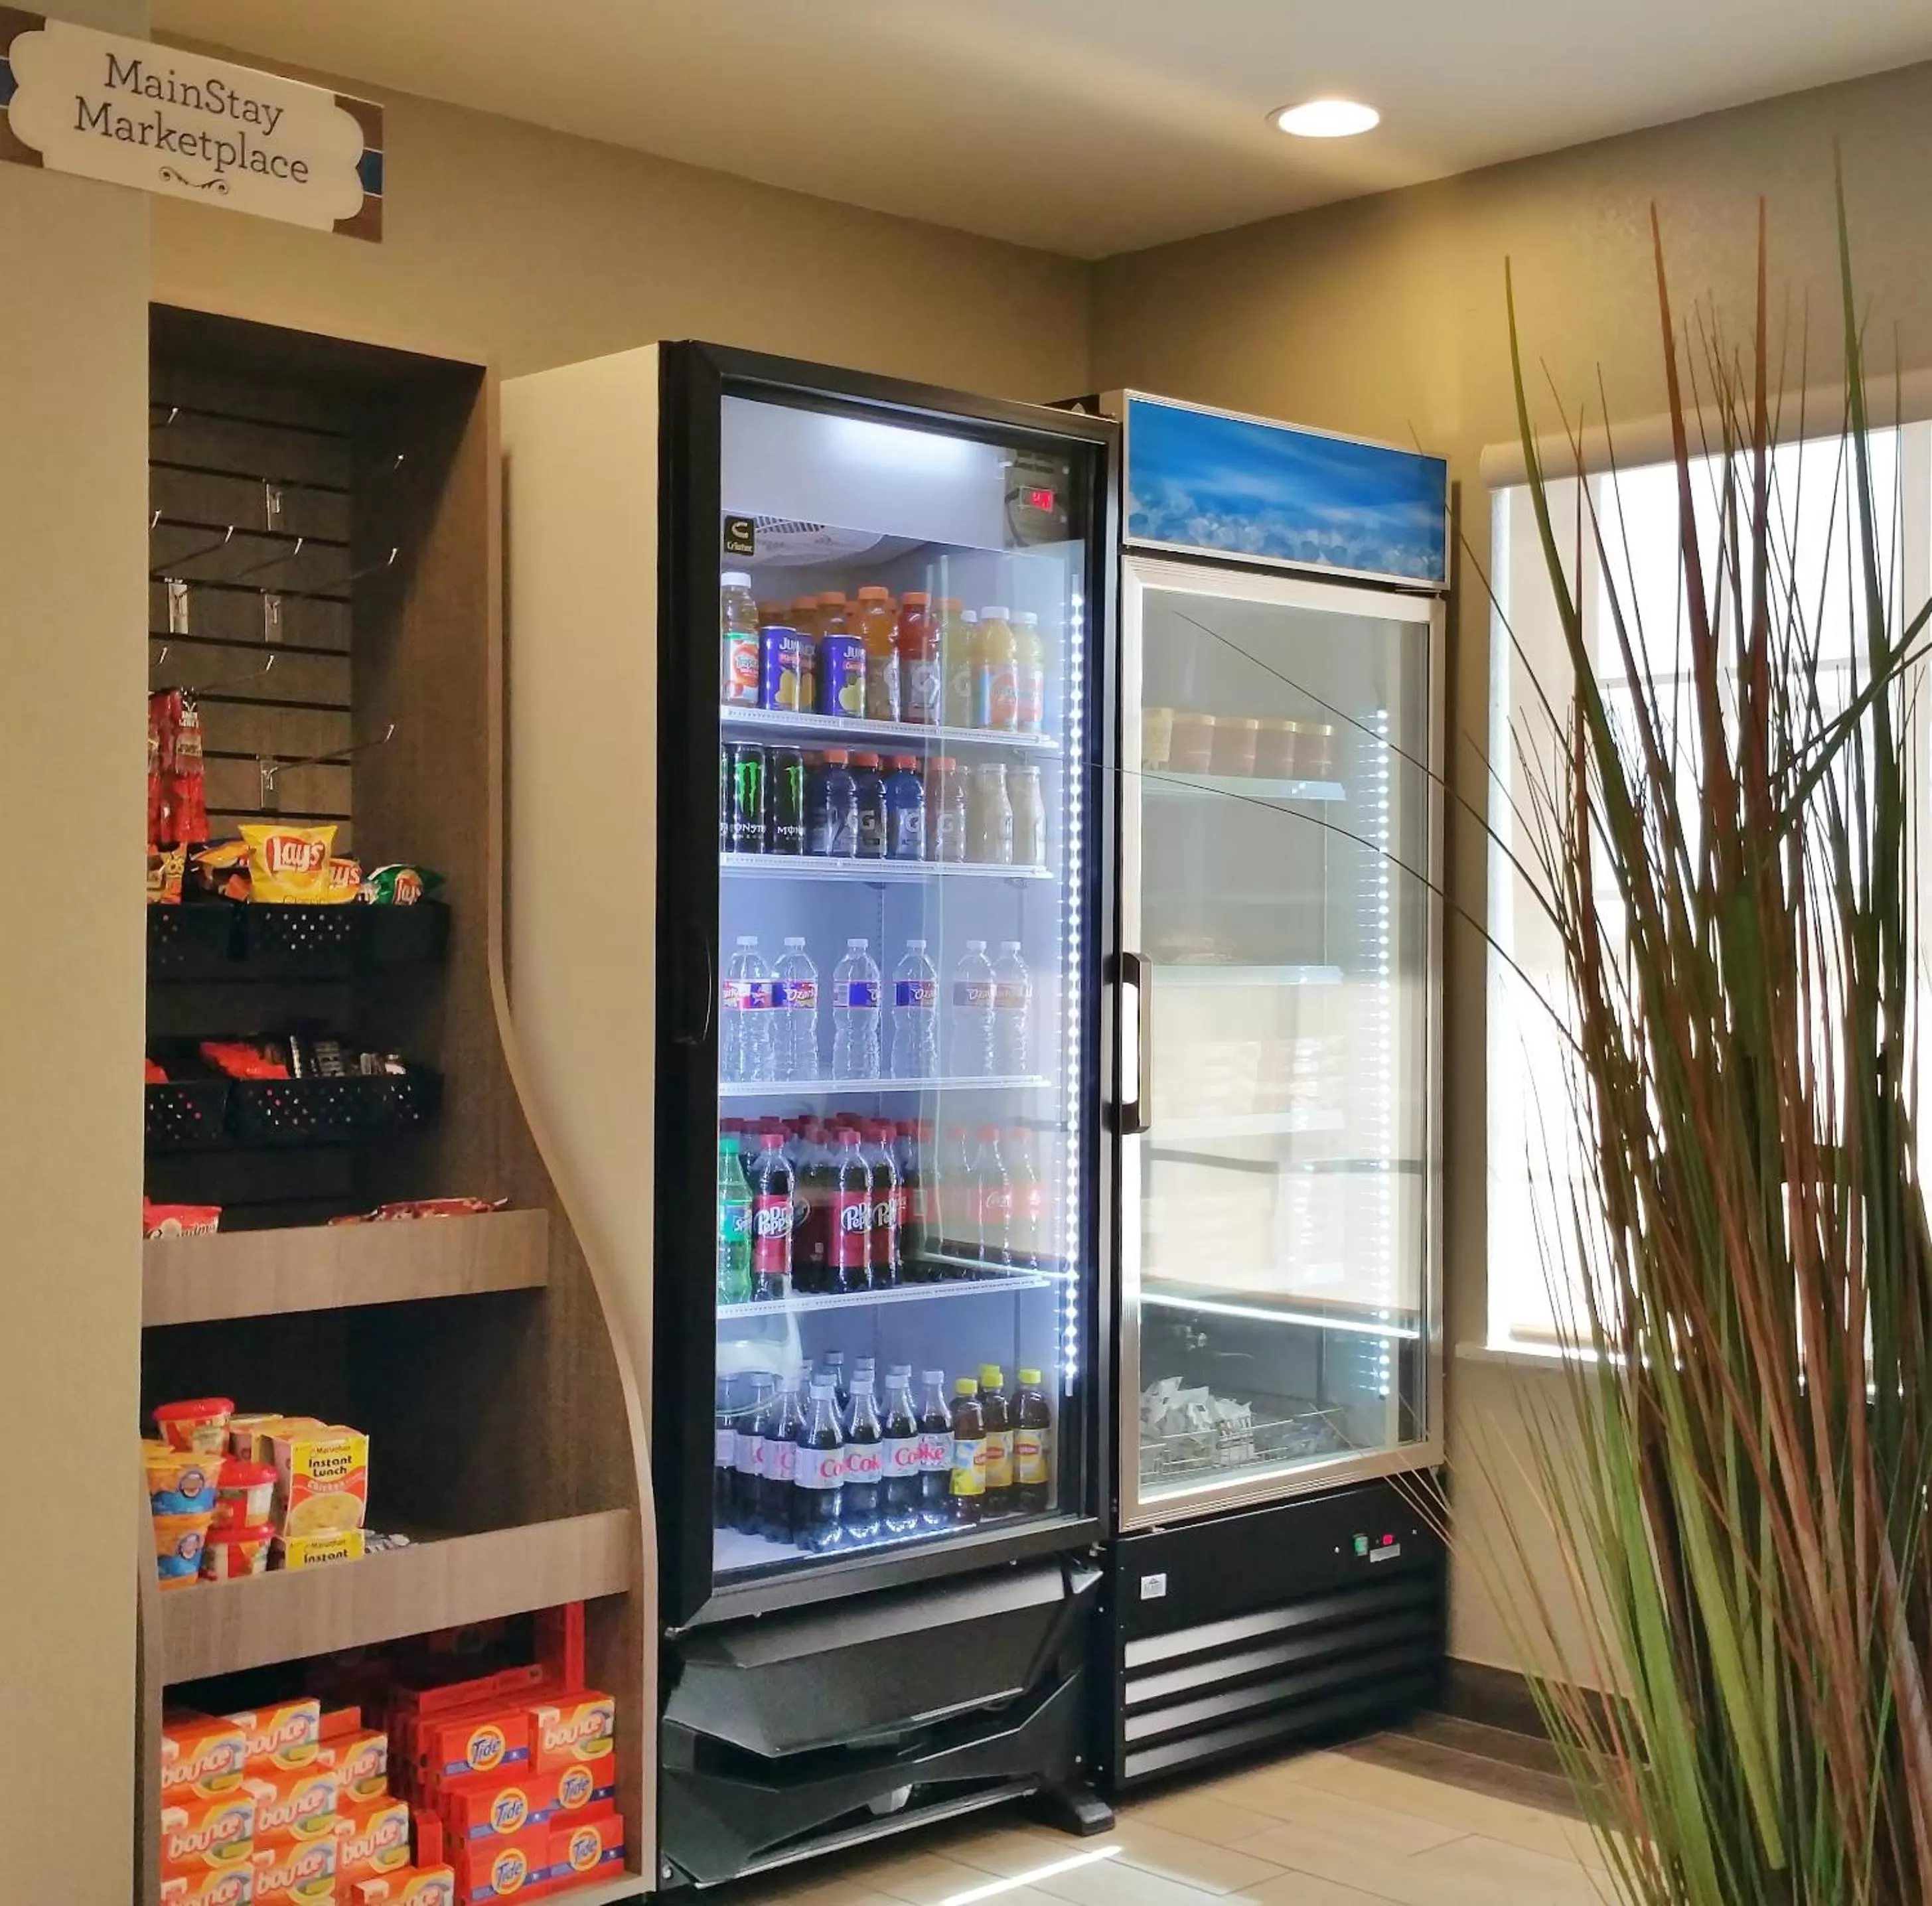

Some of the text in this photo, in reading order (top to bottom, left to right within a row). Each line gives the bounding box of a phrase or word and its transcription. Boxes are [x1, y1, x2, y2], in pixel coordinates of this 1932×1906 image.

[104, 52, 285, 136] MainStay
[74, 96, 309, 184] Marketplace
[758, 1210, 790, 1235] Pepp
[309, 1455, 352, 1468] Instant
[313, 1466, 347, 1477] Lunch
[820, 1459, 843, 1477] Co
[848, 1453, 881, 1472] Cok
[304, 1549, 348, 1564] Instant
[473, 1738, 500, 1763] Tide
[563, 1777, 589, 1800] Tide
[496, 1800, 523, 1824] Tide
[573, 1839, 597, 1864] Tide
[496, 1861, 522, 1885] Tide
